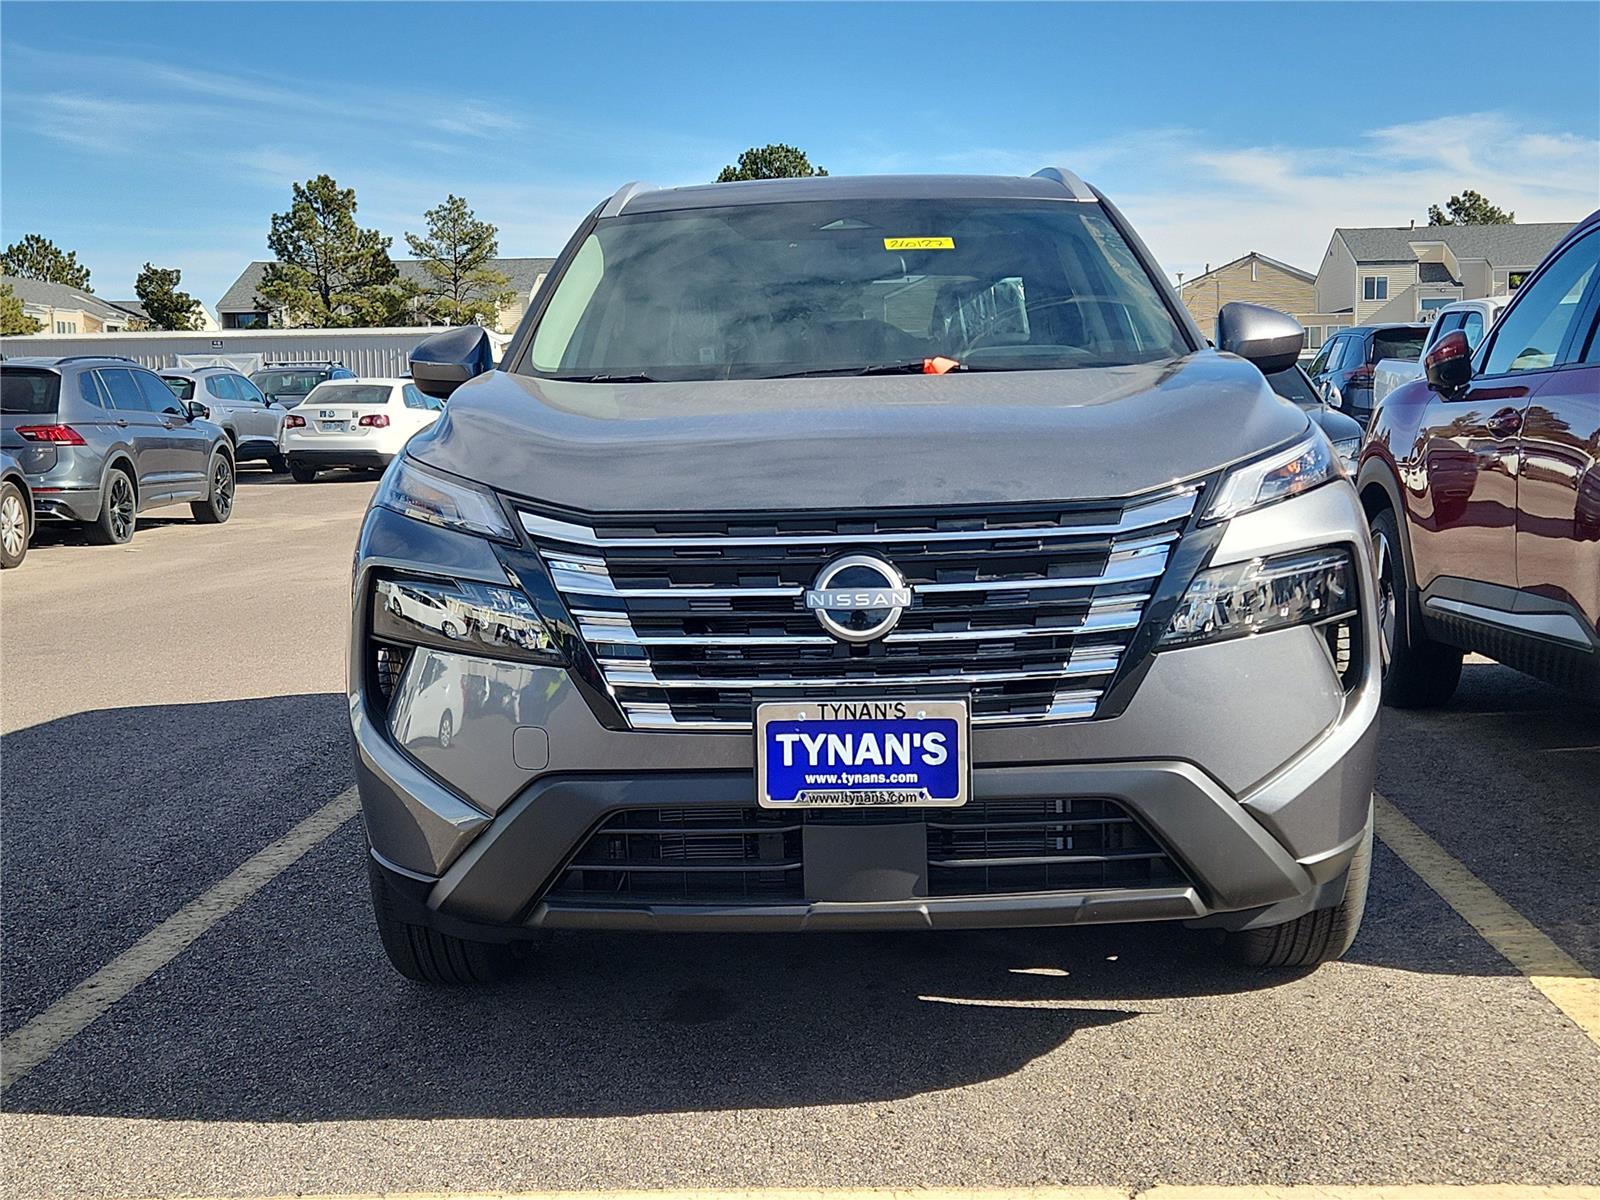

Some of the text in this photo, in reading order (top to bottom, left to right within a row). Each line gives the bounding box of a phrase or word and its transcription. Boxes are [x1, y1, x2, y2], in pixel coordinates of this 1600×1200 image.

[809, 592, 909, 607] NISSAN
[817, 703, 906, 720] TYNAN'S
[776, 732, 948, 766] TYNAN'S
[805, 772, 918, 786] www.tynans.com
[808, 790, 917, 804] www.tynans.com
